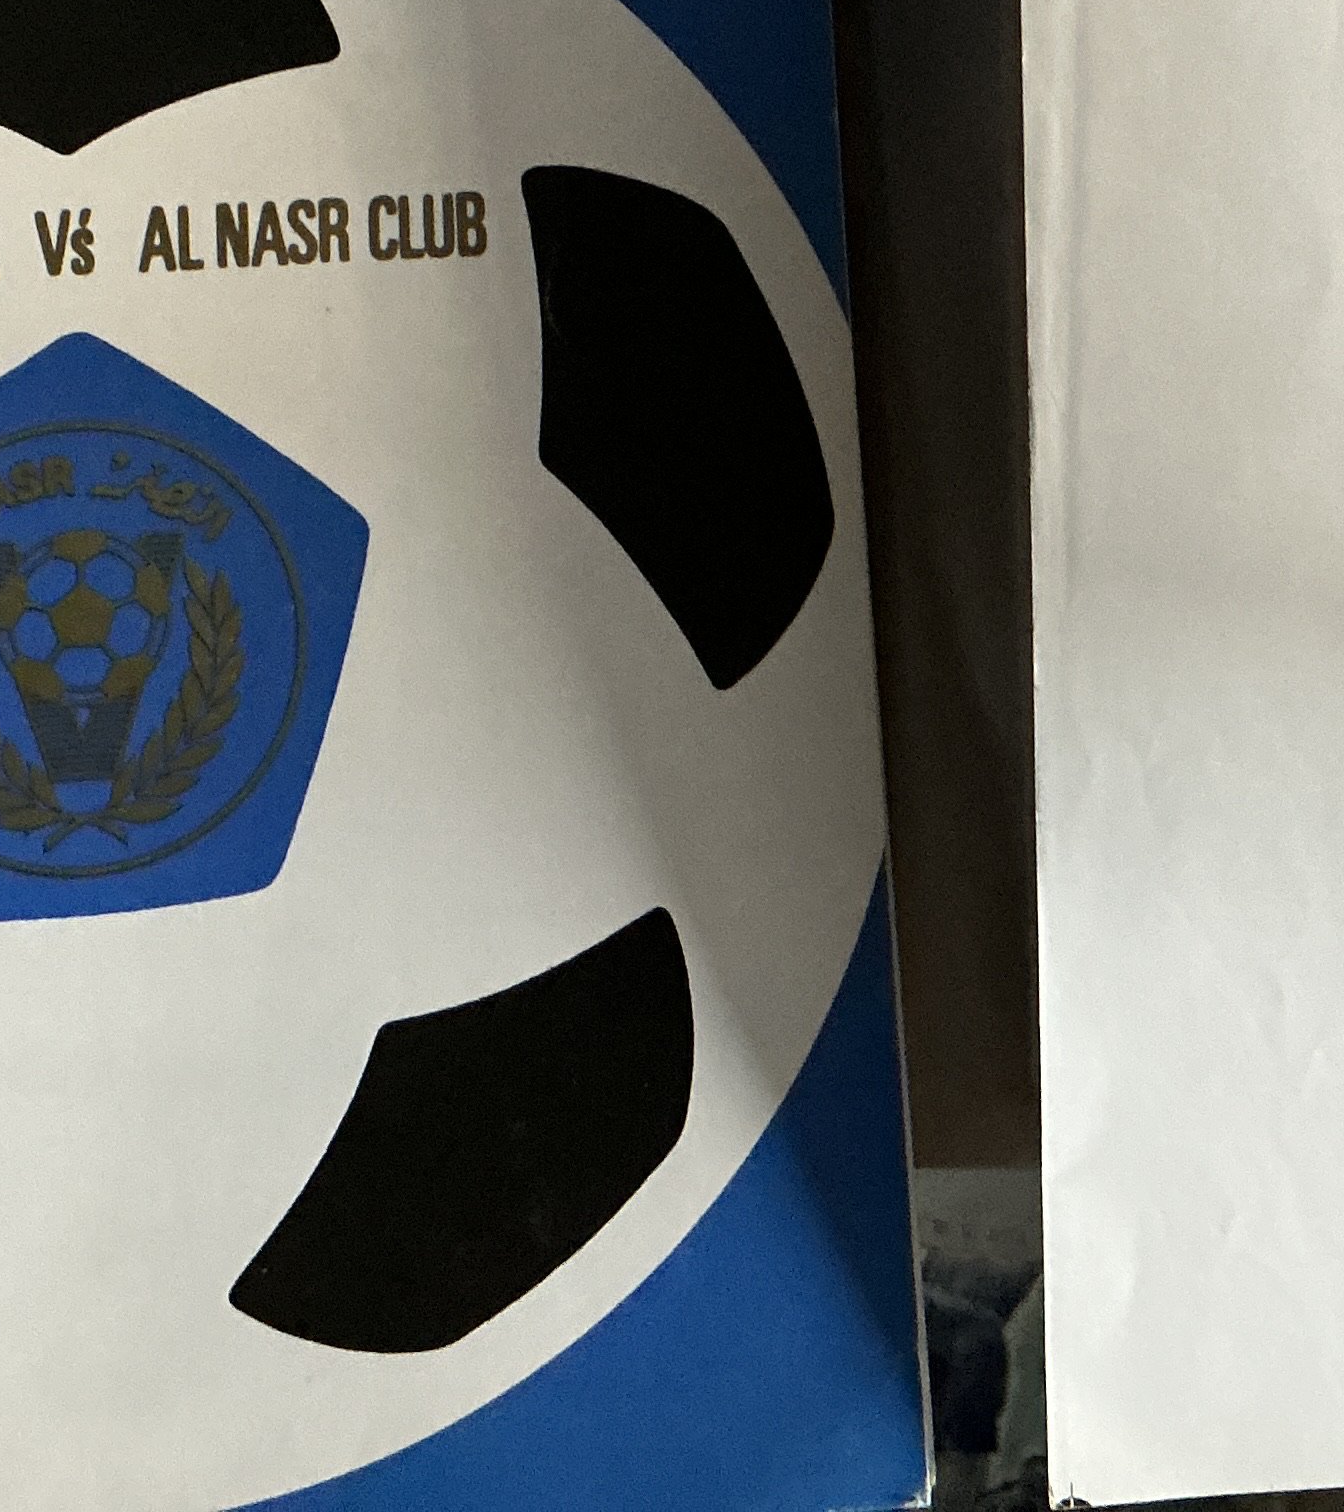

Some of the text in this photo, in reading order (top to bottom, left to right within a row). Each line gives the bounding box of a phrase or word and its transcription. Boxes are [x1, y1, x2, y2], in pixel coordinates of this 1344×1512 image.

[139, 204, 205, 274] AL
[216, 197, 350, 270] NASR
[368, 190, 488, 262] CLUB
